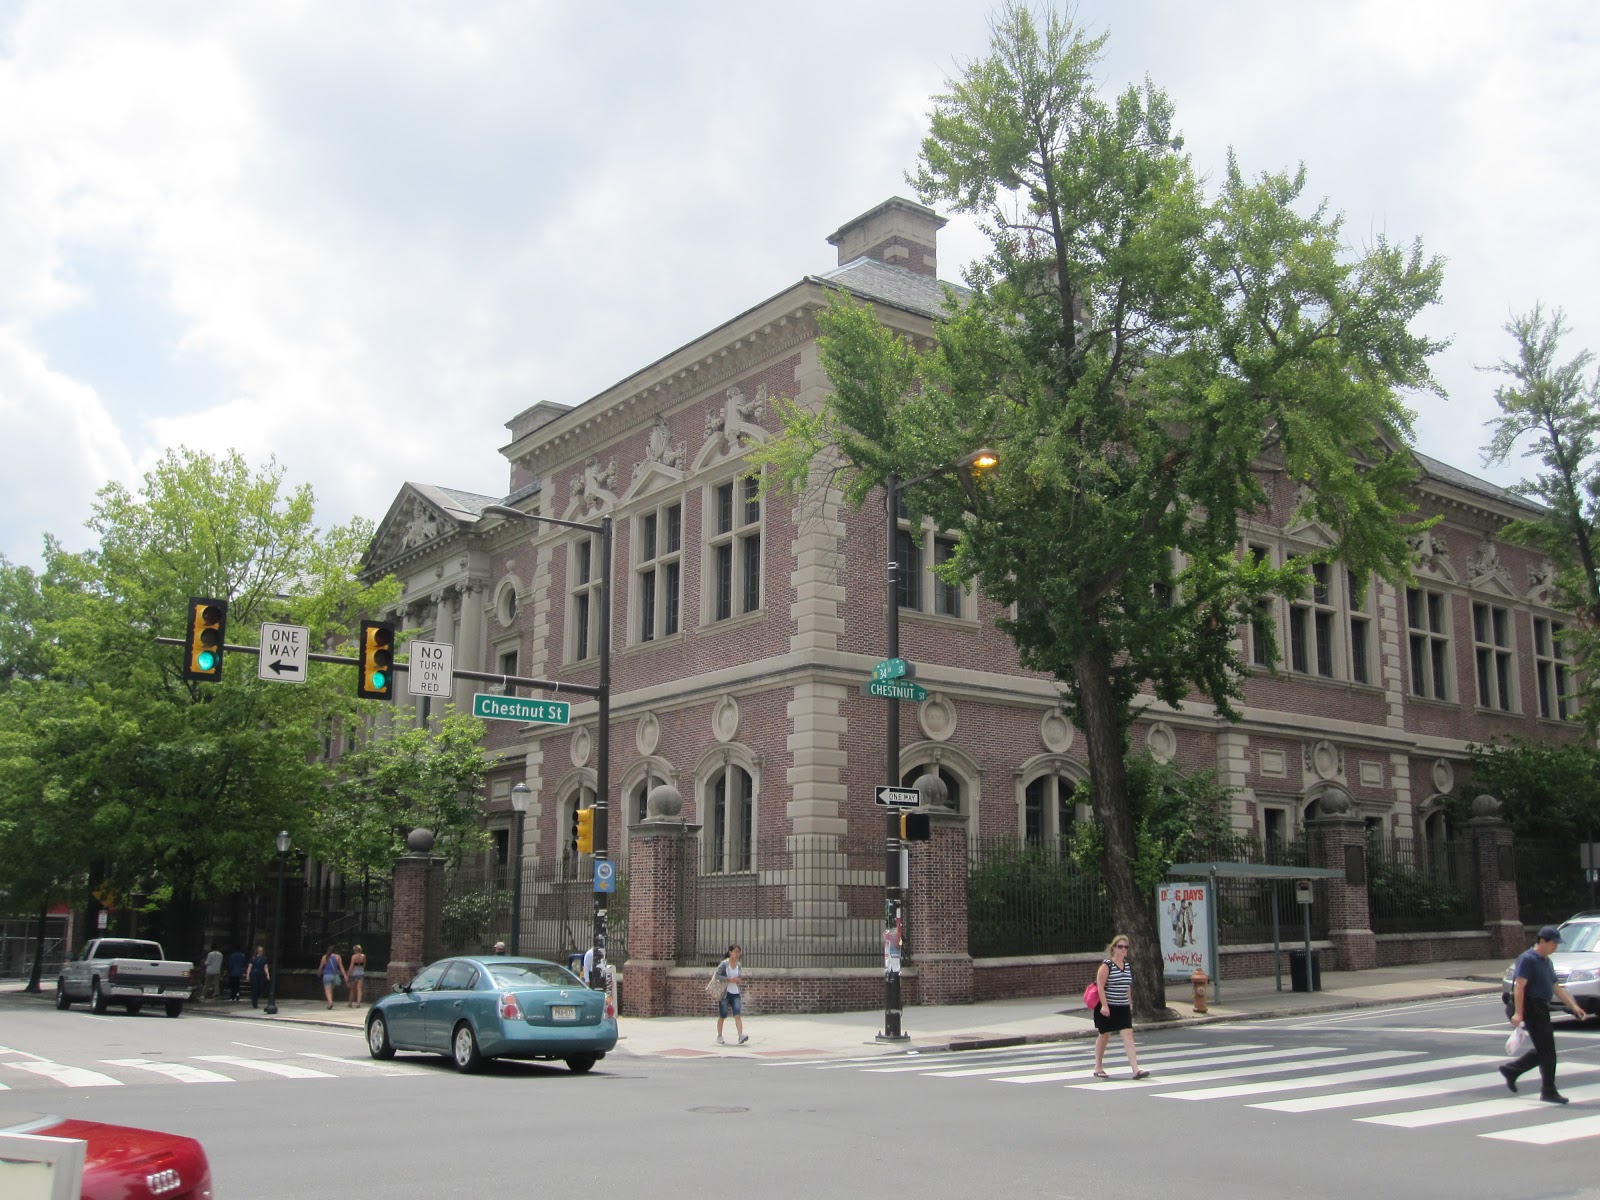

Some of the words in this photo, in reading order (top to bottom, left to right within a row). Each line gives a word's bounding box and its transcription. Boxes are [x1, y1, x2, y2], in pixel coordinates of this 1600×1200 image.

[271, 629, 299, 643] ONE
[269, 644, 299, 657] WAY
[421, 647, 443, 659] NO
[419, 661, 444, 671] TURN
[423, 671, 438, 681] ON
[421, 682, 439, 692] RED
[870, 684, 914, 699] CHESTNUT
[918, 692, 925, 700] ST
[481, 700, 544, 719] Chestnut
[548, 705, 562, 720] St
[889, 792, 902, 801] ONE
[904, 793, 916, 802] WAY
[1183, 889, 1204, 901] DAYS
[1191, 952, 1203, 964] Kid
